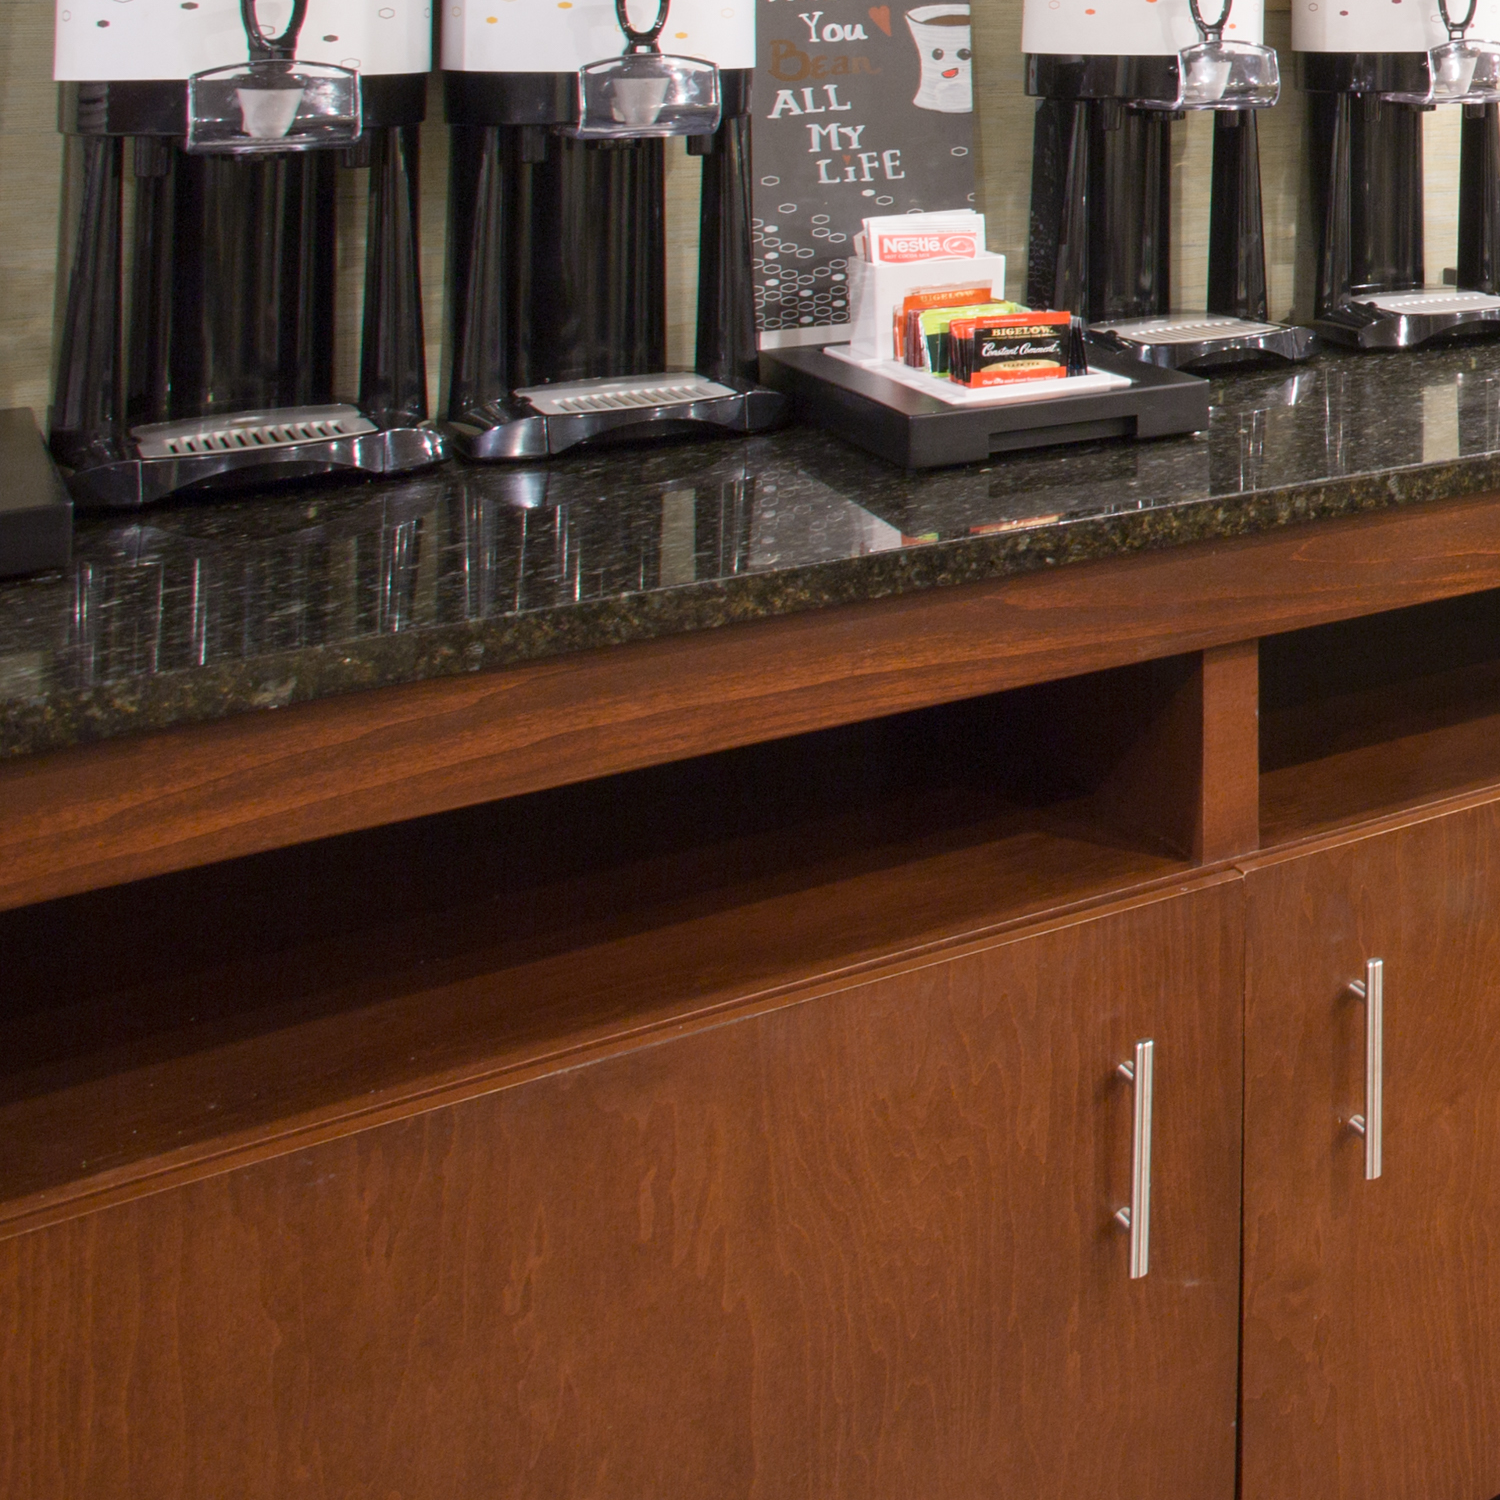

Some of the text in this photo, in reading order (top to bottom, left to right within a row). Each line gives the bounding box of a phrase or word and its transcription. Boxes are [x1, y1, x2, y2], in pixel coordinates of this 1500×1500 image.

[767, 39, 882, 82] Bean
[766, 84, 852, 119] ALL
[805, 122, 865, 153] MY
[920, 289, 976, 303] BIGELOW
[991, 325, 1053, 337] BIGELOW
